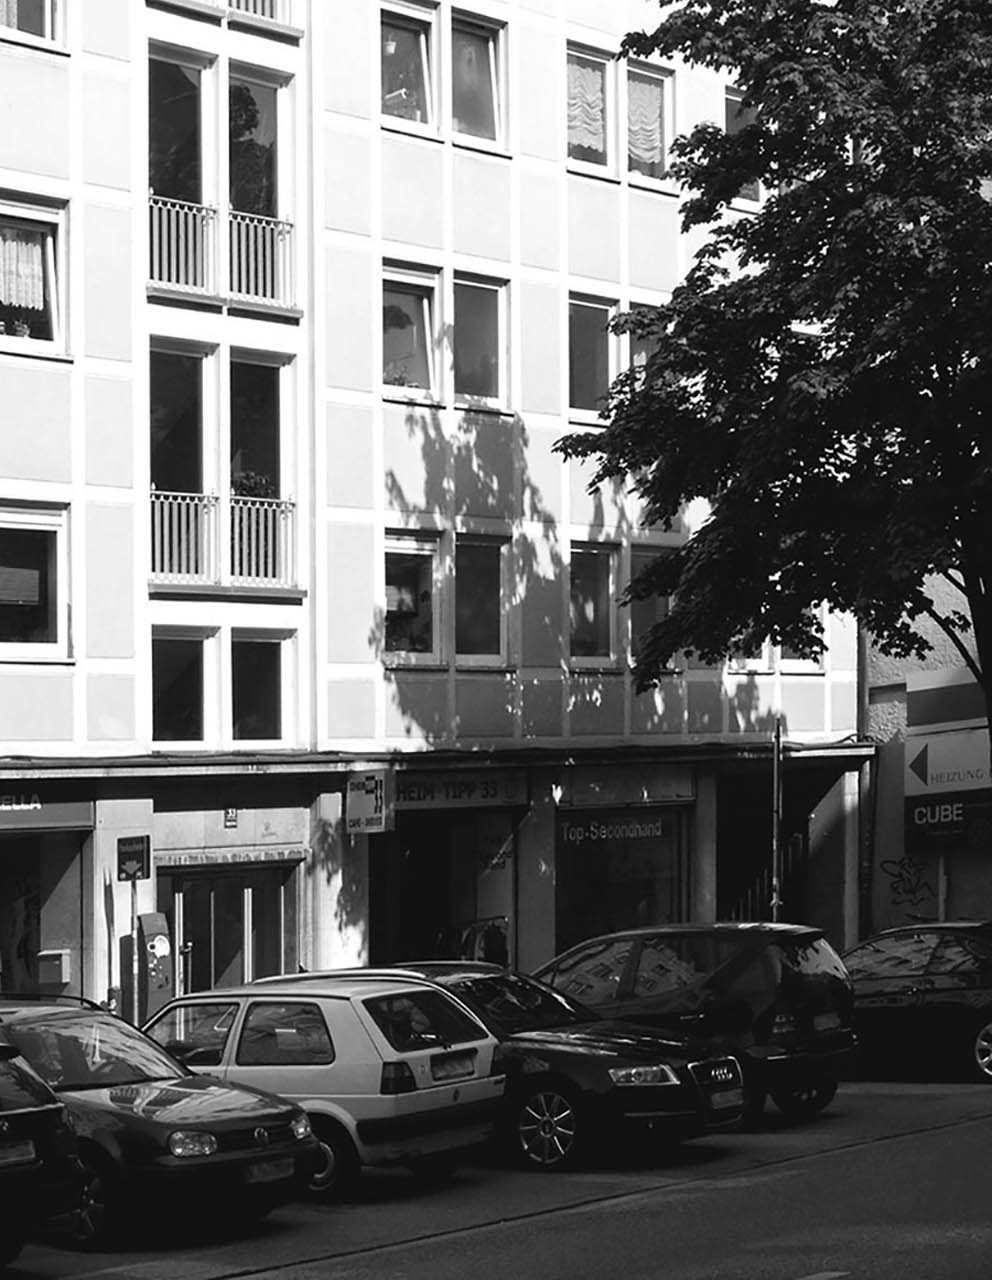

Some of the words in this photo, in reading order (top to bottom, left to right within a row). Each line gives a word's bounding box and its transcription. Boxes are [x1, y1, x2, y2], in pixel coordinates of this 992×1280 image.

[930, 768, 985, 785] HEIZUNG
[481, 780, 498, 799] 33
[914, 802, 964, 825] CUBE
[561, 816, 663, 846] Top-Secondhand
